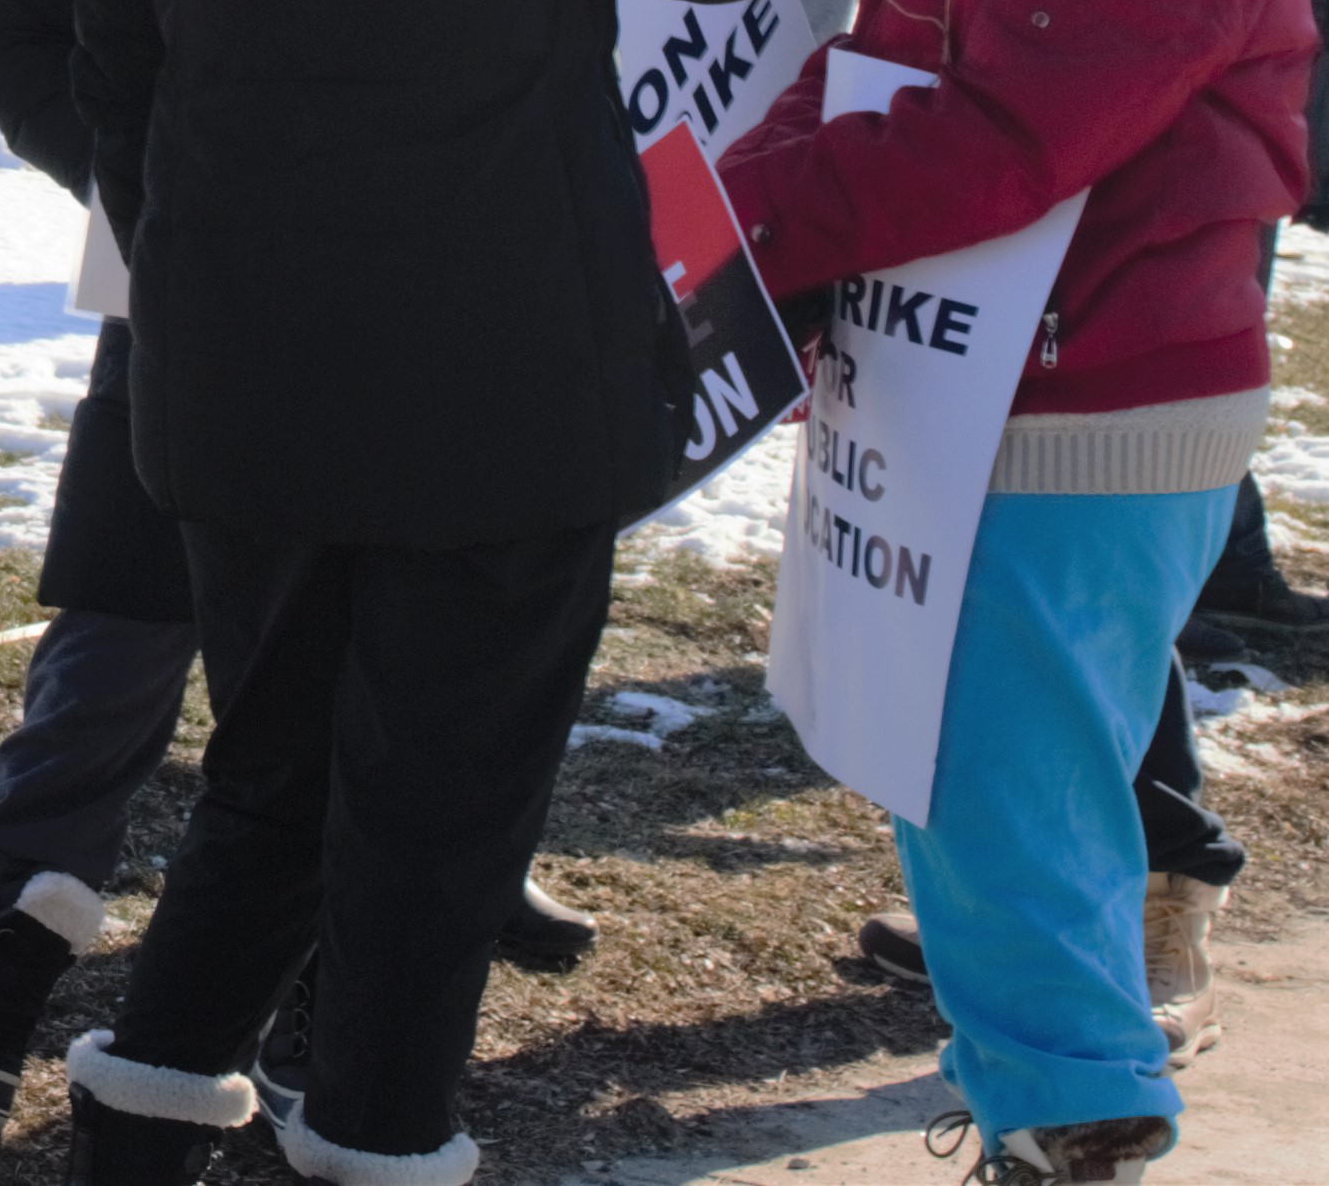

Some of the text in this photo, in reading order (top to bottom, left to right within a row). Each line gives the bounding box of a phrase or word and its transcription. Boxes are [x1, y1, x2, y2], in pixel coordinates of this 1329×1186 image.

[628, 6, 708, 136] ON
[839, 273, 980, 357] RIKE
[822, 350, 857, 409] OR
[806, 412, 888, 503] UBLIC
